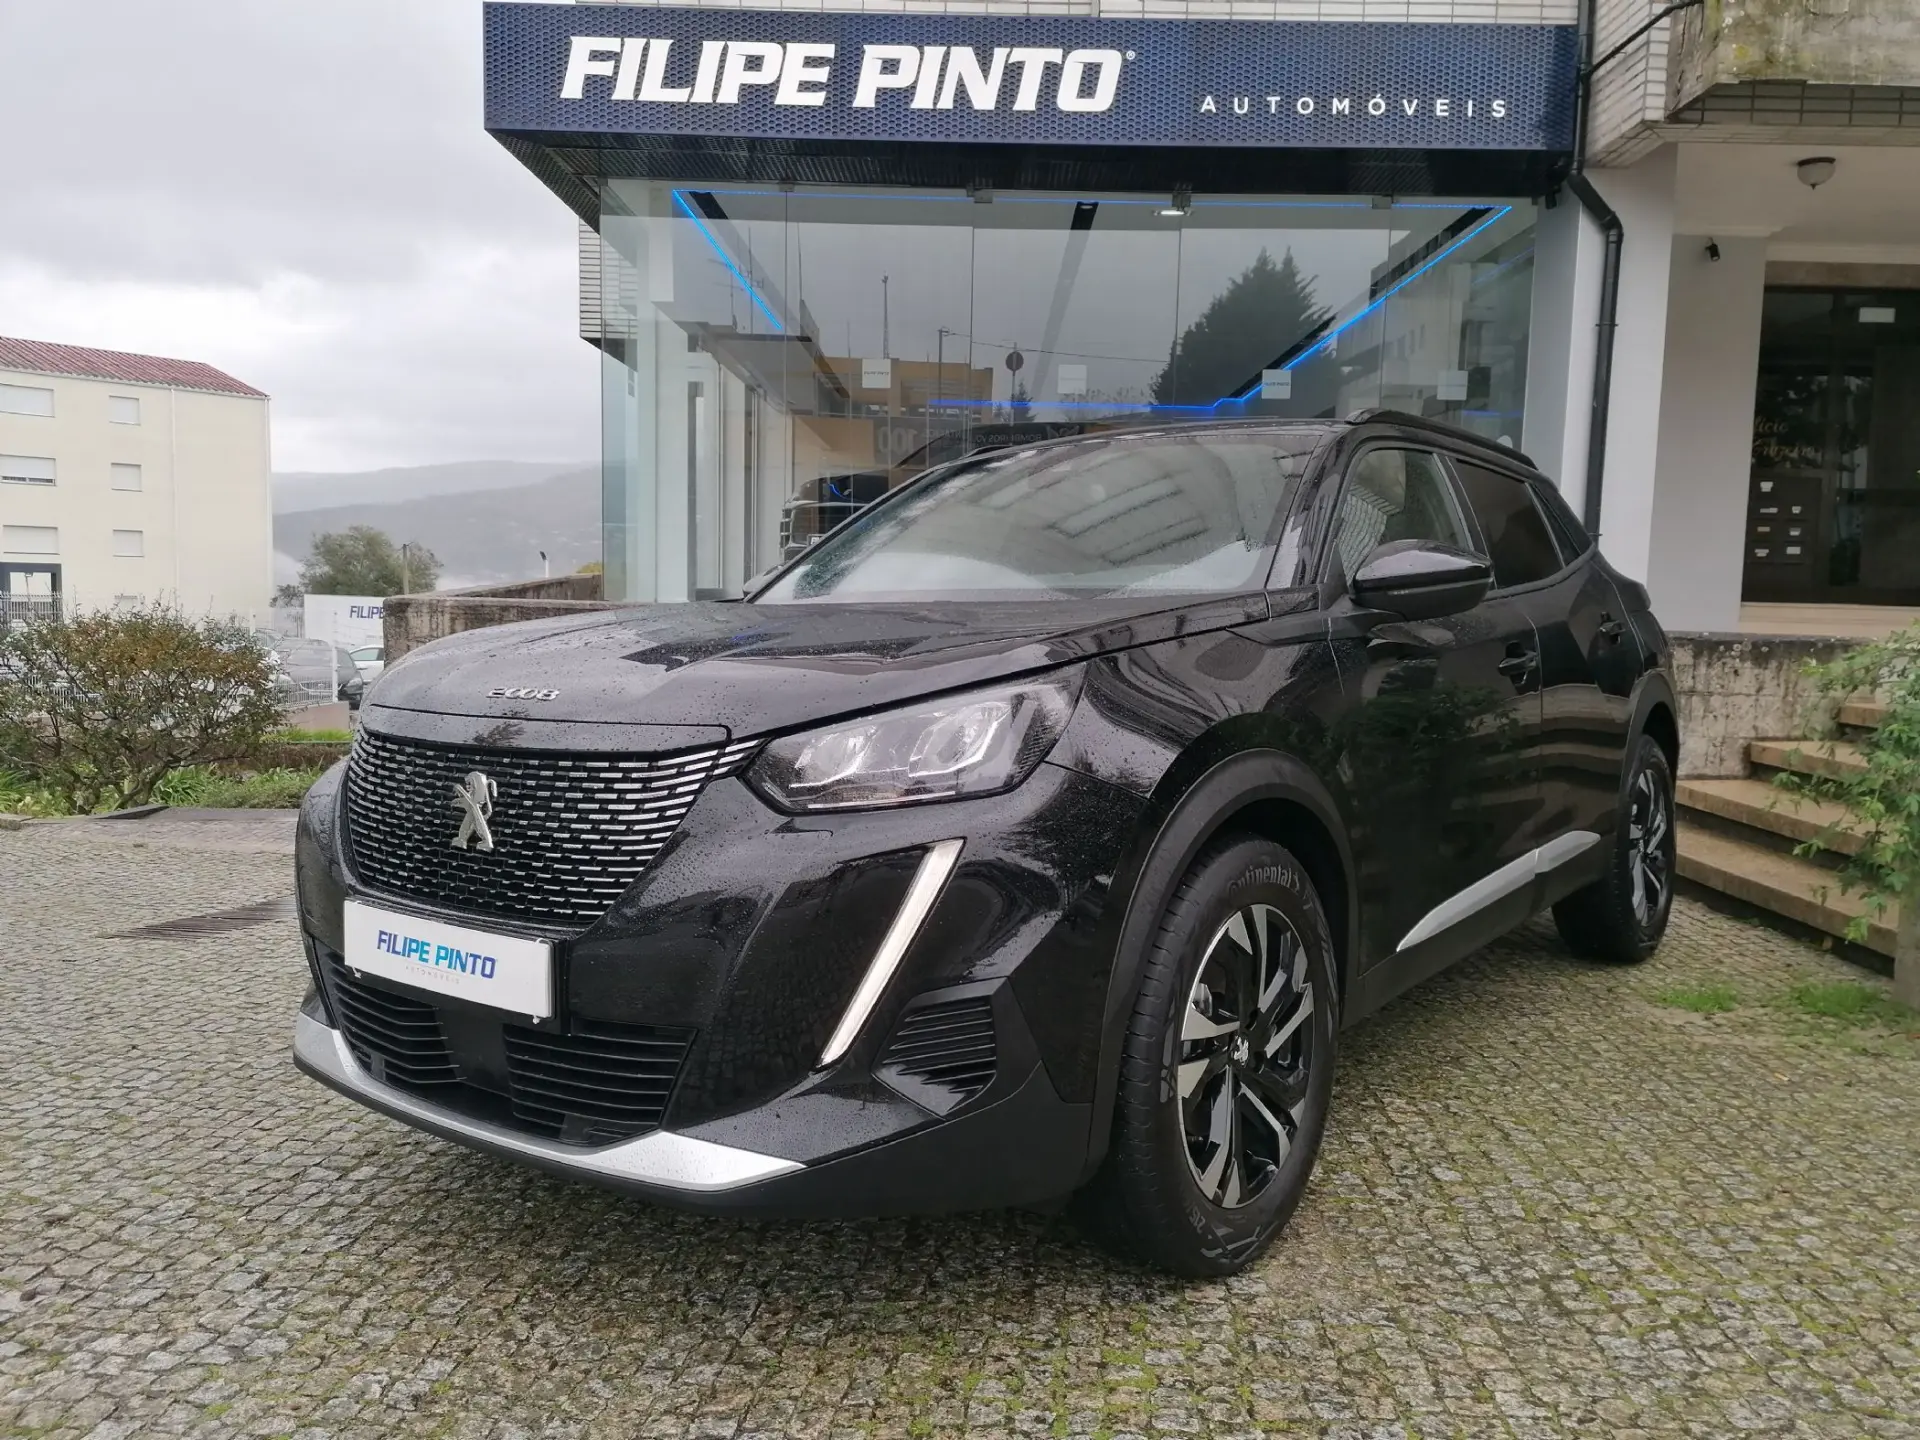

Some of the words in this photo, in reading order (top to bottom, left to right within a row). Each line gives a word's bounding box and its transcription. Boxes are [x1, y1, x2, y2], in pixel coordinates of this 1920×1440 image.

[559, 35, 835, 106] FILIPE
[852, 44, 1123, 112] PINTO
[1200, 94, 1507, 118] AUTOMÓVEIS
[377, 930, 431, 963] FILIPE
[435, 944, 497, 979] PINTO
